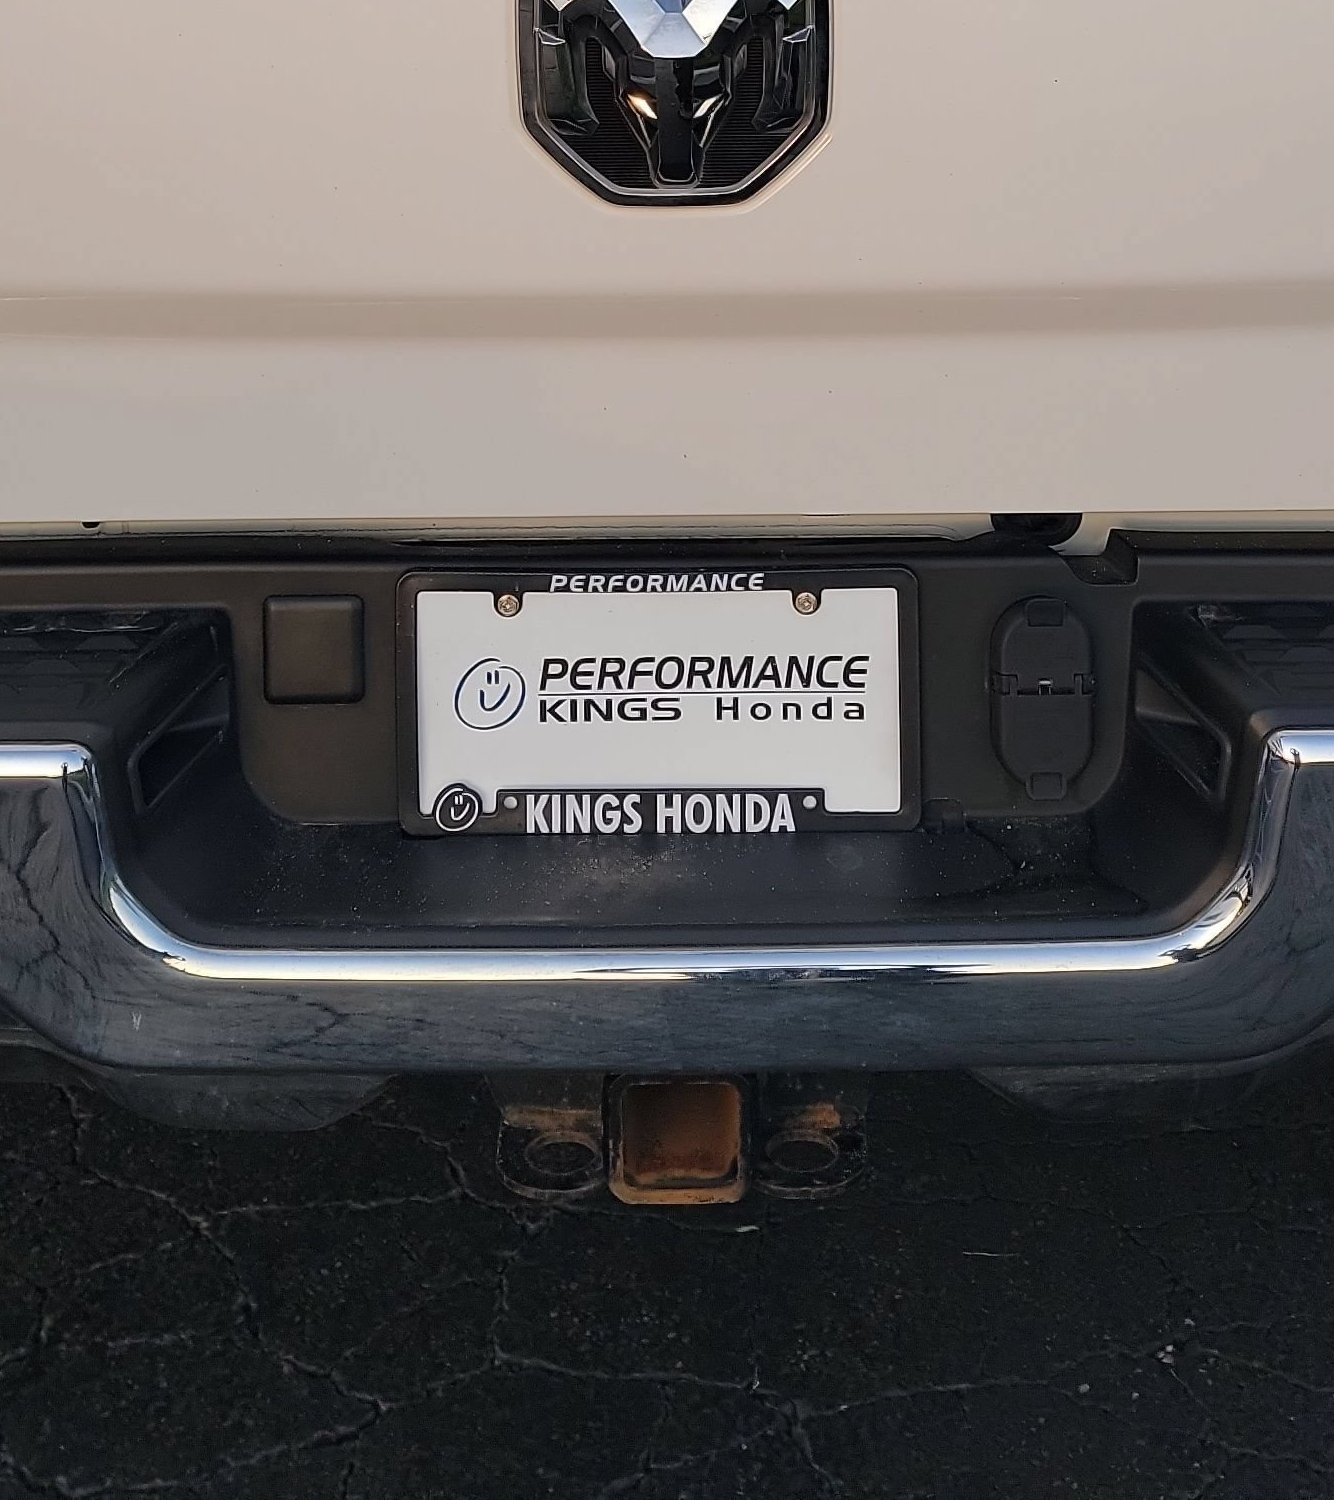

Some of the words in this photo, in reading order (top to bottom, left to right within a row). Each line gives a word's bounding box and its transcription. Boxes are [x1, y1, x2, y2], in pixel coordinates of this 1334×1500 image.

[549, 573, 765, 593] PERFORMANCE
[539, 655, 870, 691] PERFORMANCE
[539, 697, 682, 723] KINGS
[715, 696, 866, 721] Honda
[525, 793, 643, 834] KINGS
[656, 793, 796, 833] HONDA
